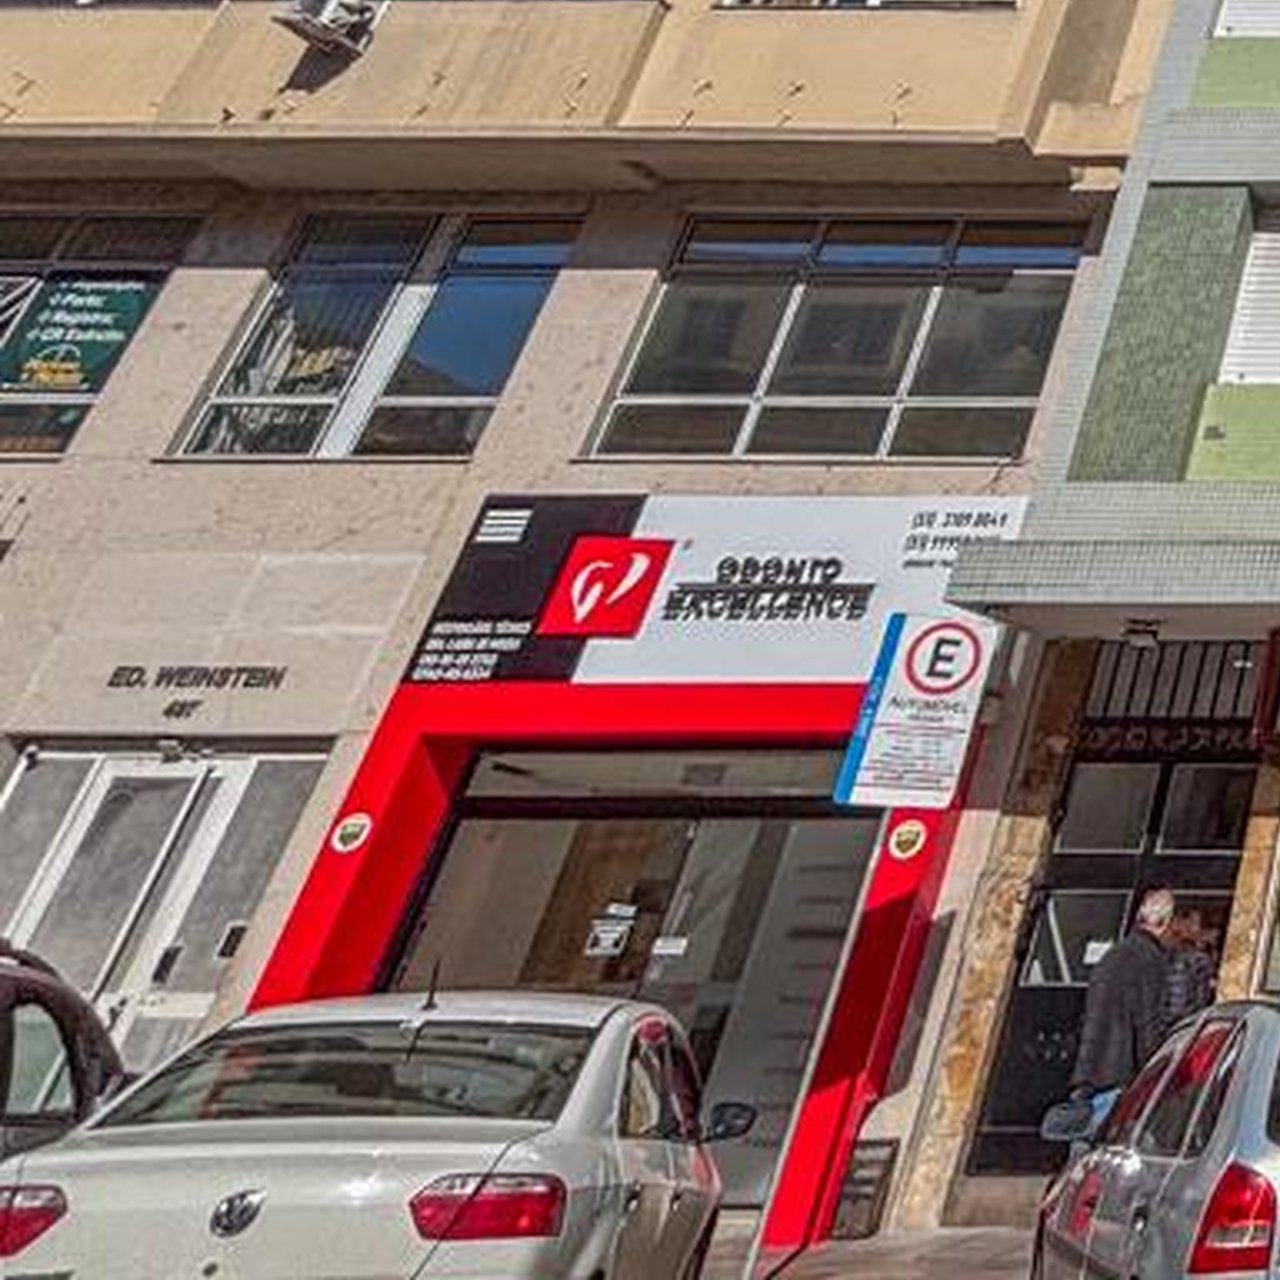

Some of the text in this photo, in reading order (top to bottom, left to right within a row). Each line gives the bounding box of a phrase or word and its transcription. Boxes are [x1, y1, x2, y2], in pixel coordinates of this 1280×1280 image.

[717, 556, 843, 584] ODONTO
[663, 589, 870, 621] EXCELLENCE
[925, 636, 964, 679] E
[154, 665, 288, 690] WEINSTEIN
